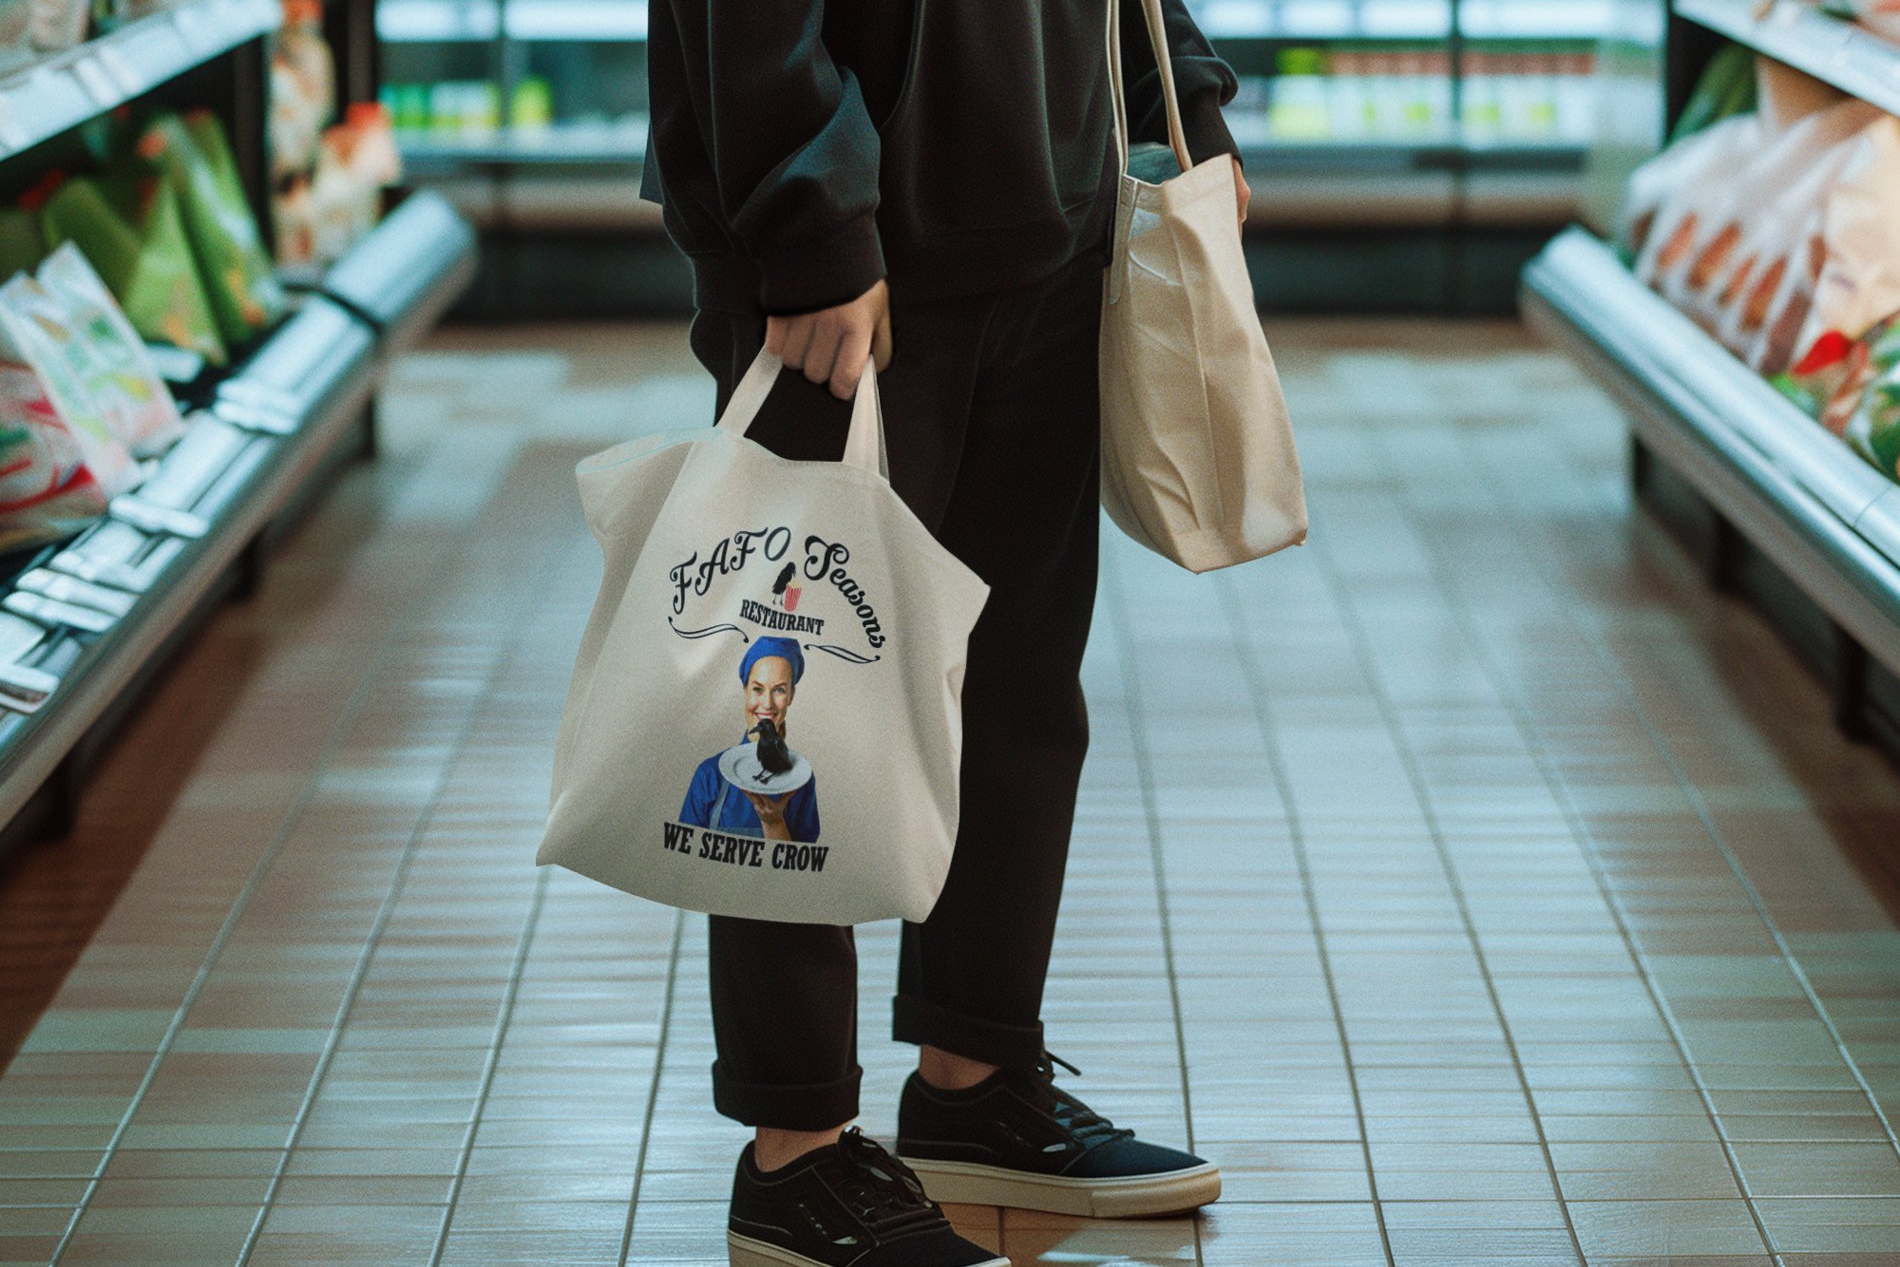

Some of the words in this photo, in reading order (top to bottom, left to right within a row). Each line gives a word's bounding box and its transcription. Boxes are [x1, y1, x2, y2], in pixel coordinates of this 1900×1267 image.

[669, 526, 791, 615] FAFO
[804, 535, 886, 649] Seasons
[739, 599, 824, 635] RESTAURANT
[664, 823, 694, 854] WE
[699, 832, 765, 867] SERVE
[772, 843, 828, 872] CROW
